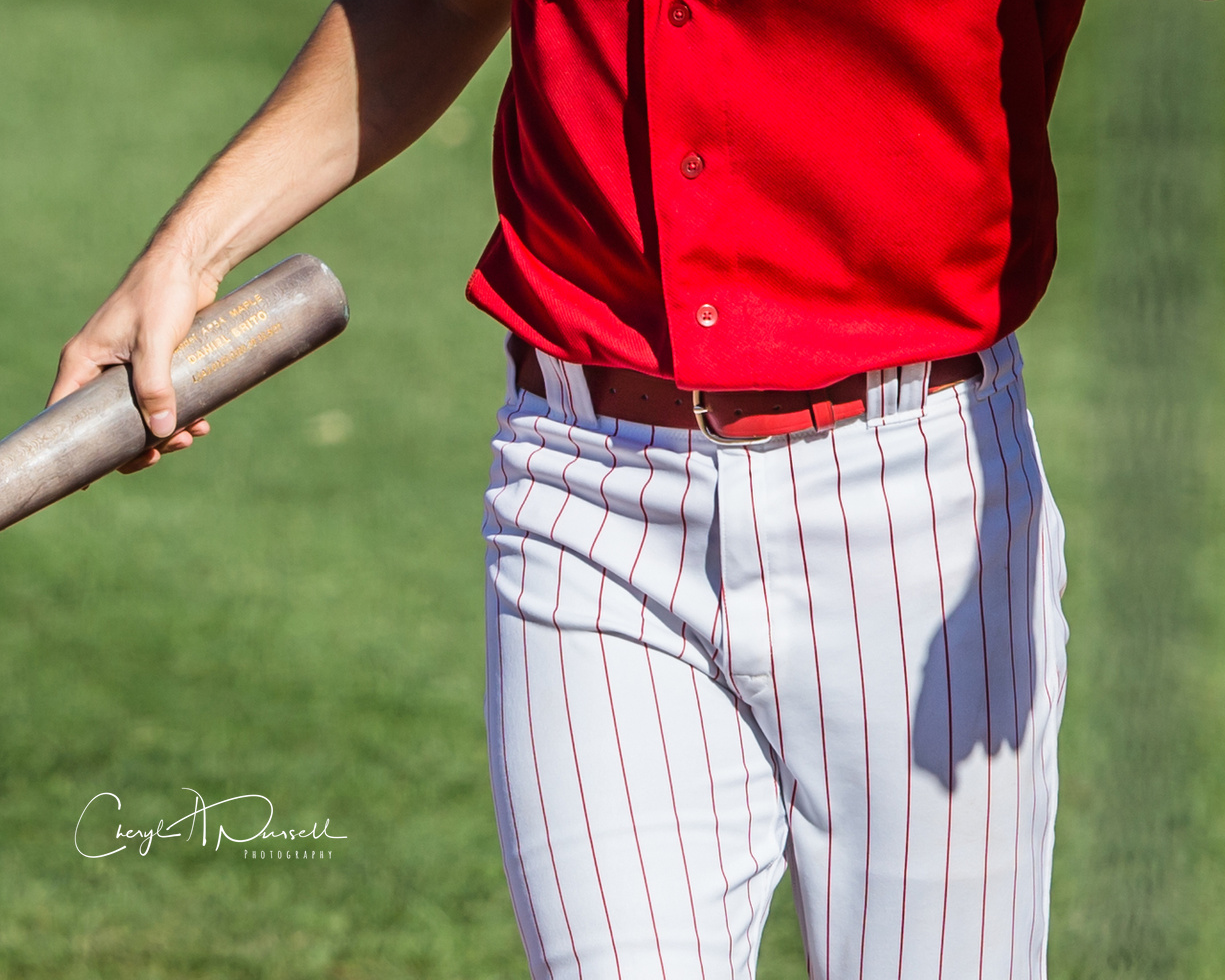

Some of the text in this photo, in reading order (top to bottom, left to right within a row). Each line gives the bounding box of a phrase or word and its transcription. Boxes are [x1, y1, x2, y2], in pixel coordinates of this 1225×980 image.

[173, 333, 198, 354] odel
[229, 293, 262, 317] MAPLE
[186, 335, 231, 365] DANIEL
[230, 310, 268, 338] BRITO
